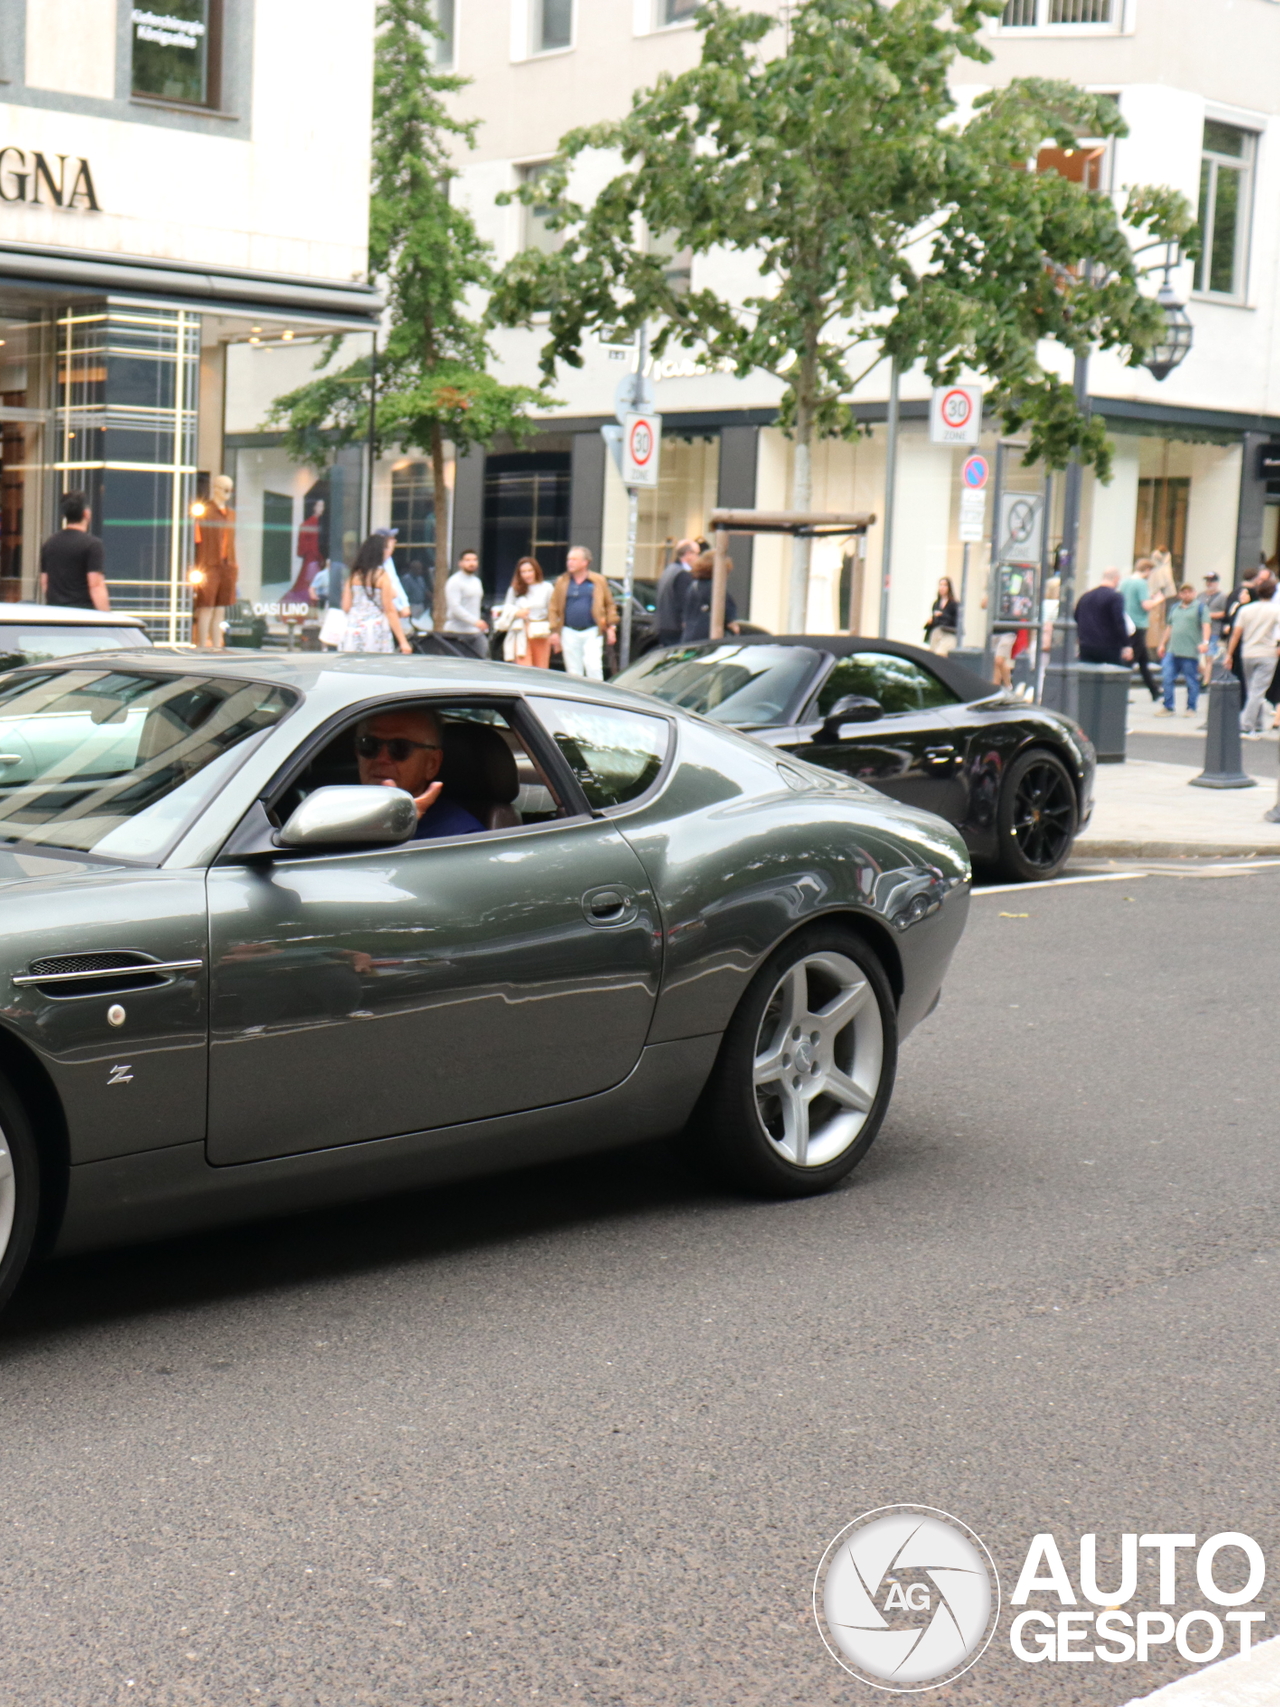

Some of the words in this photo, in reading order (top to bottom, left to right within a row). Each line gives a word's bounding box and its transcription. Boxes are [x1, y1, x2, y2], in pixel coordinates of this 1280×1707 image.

[137, 25, 196, 49] Königsallee
[948, 400, 967, 418] 30
[635, 433, 649, 453] 30
[943, 431, 967, 440] ZONE
[631, 469, 649, 481] ZONE
[253, 602, 280, 616] OASI
[282, 602, 309, 616] LINO
